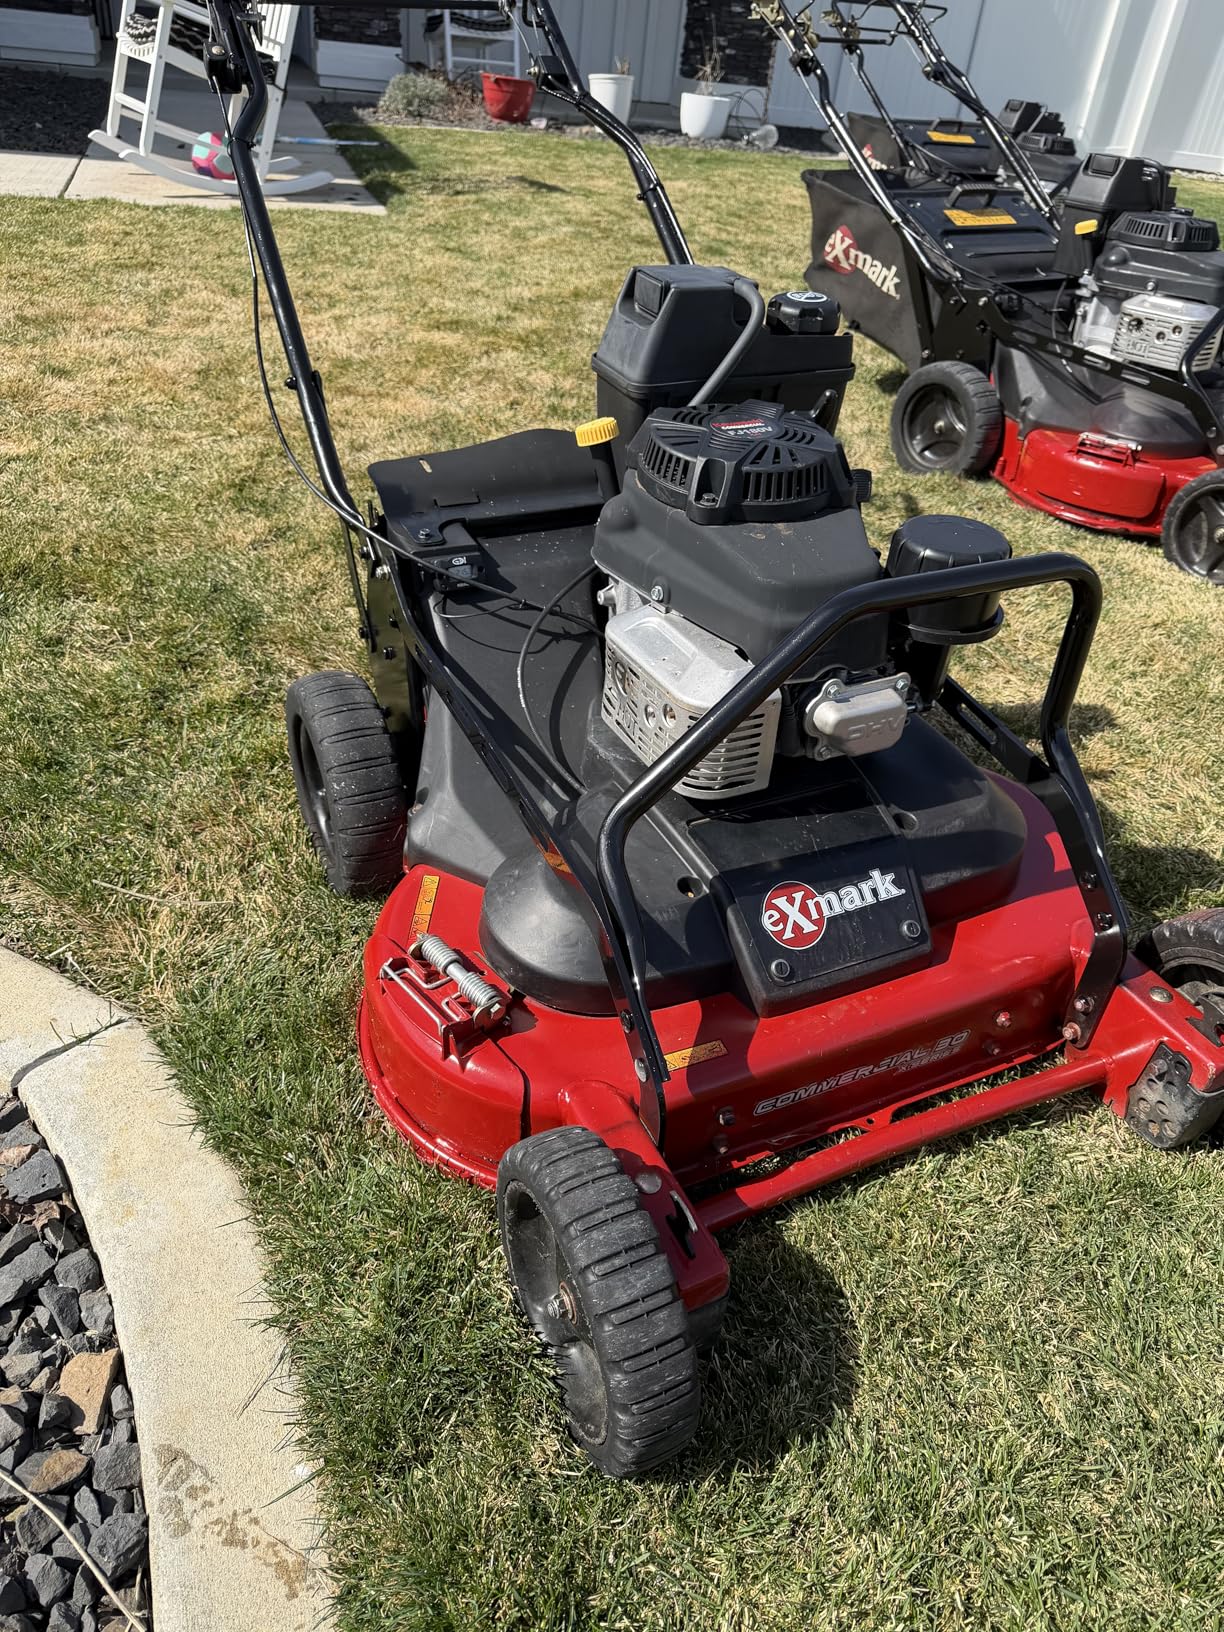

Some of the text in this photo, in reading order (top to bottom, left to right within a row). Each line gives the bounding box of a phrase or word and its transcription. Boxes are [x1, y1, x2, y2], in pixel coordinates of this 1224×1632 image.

[763, 869, 902, 940] eXmark
[754, 1030, 970, 1115] COMMERCIAL 30
